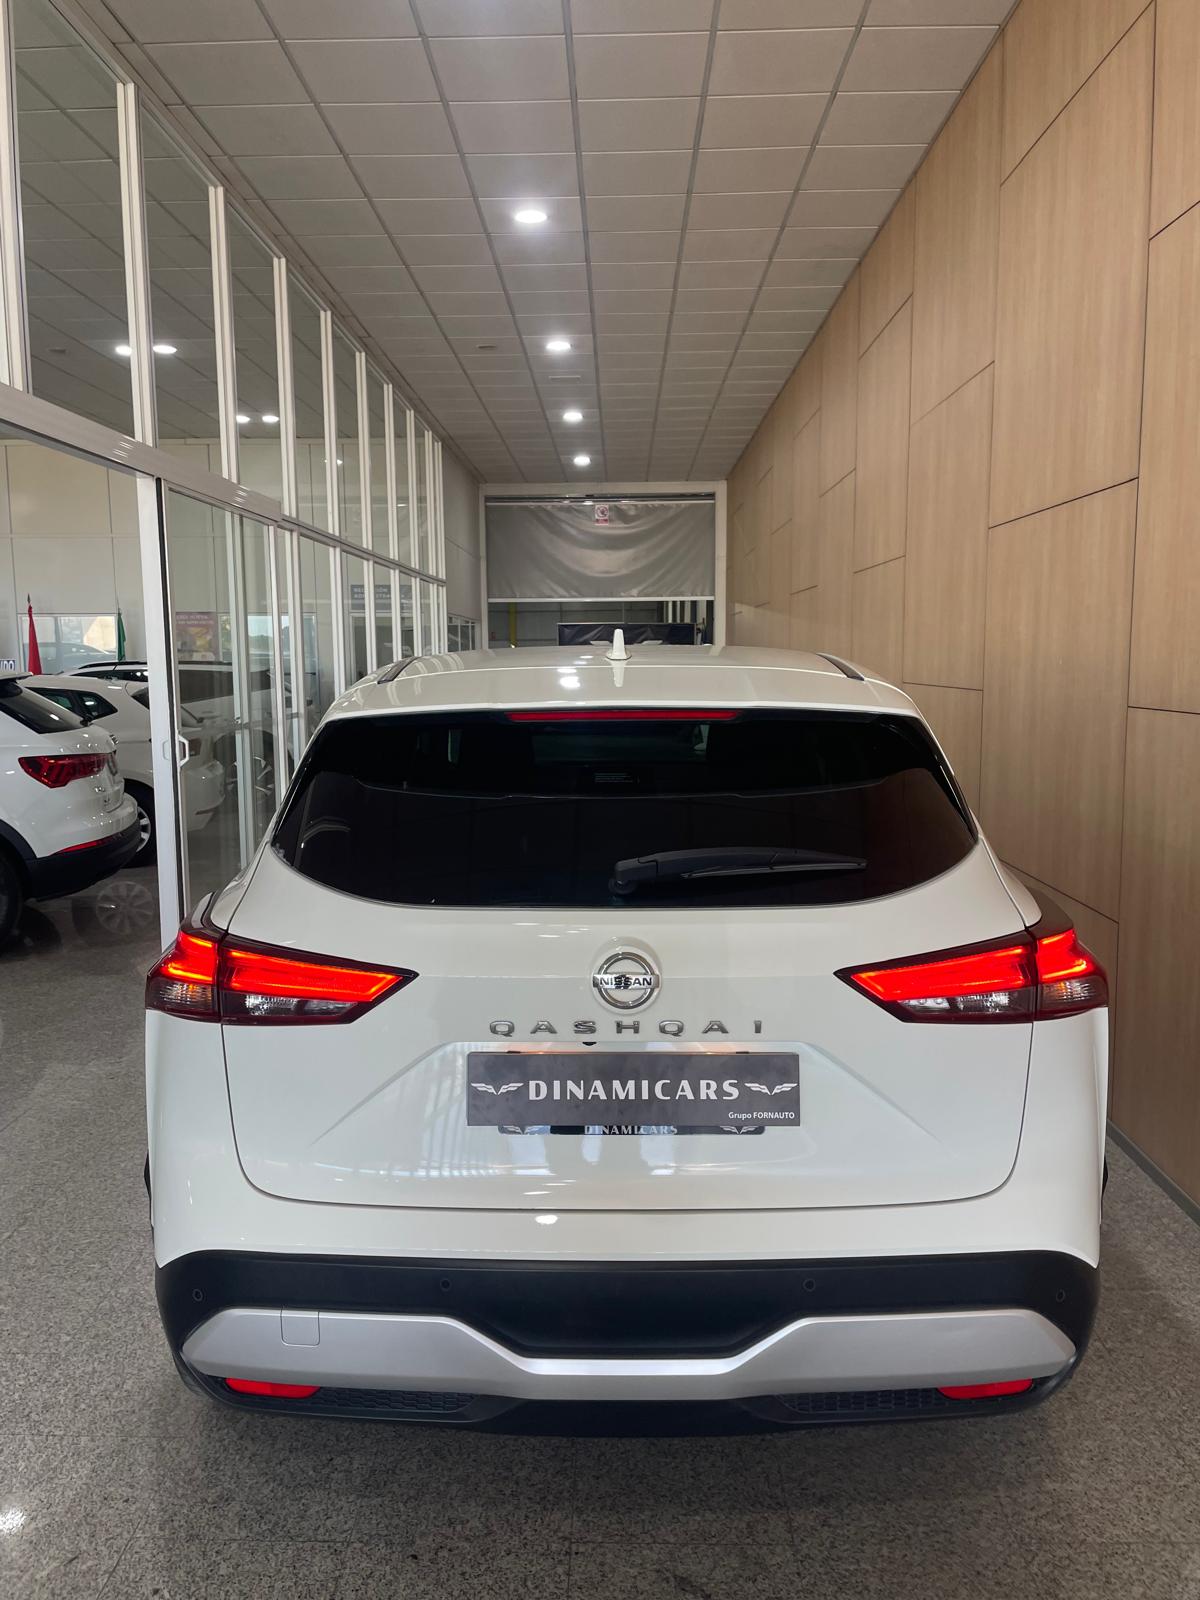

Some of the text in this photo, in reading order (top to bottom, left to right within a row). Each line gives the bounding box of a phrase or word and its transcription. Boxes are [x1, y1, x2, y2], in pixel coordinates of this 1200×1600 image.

[600, 976, 653, 988] NISSAN
[489, 1020, 763, 1037] QASHQAI
[528, 1079, 740, 1101] DINAMICARS
[728, 1111, 796, 1121] Grupo FORNAUTO
